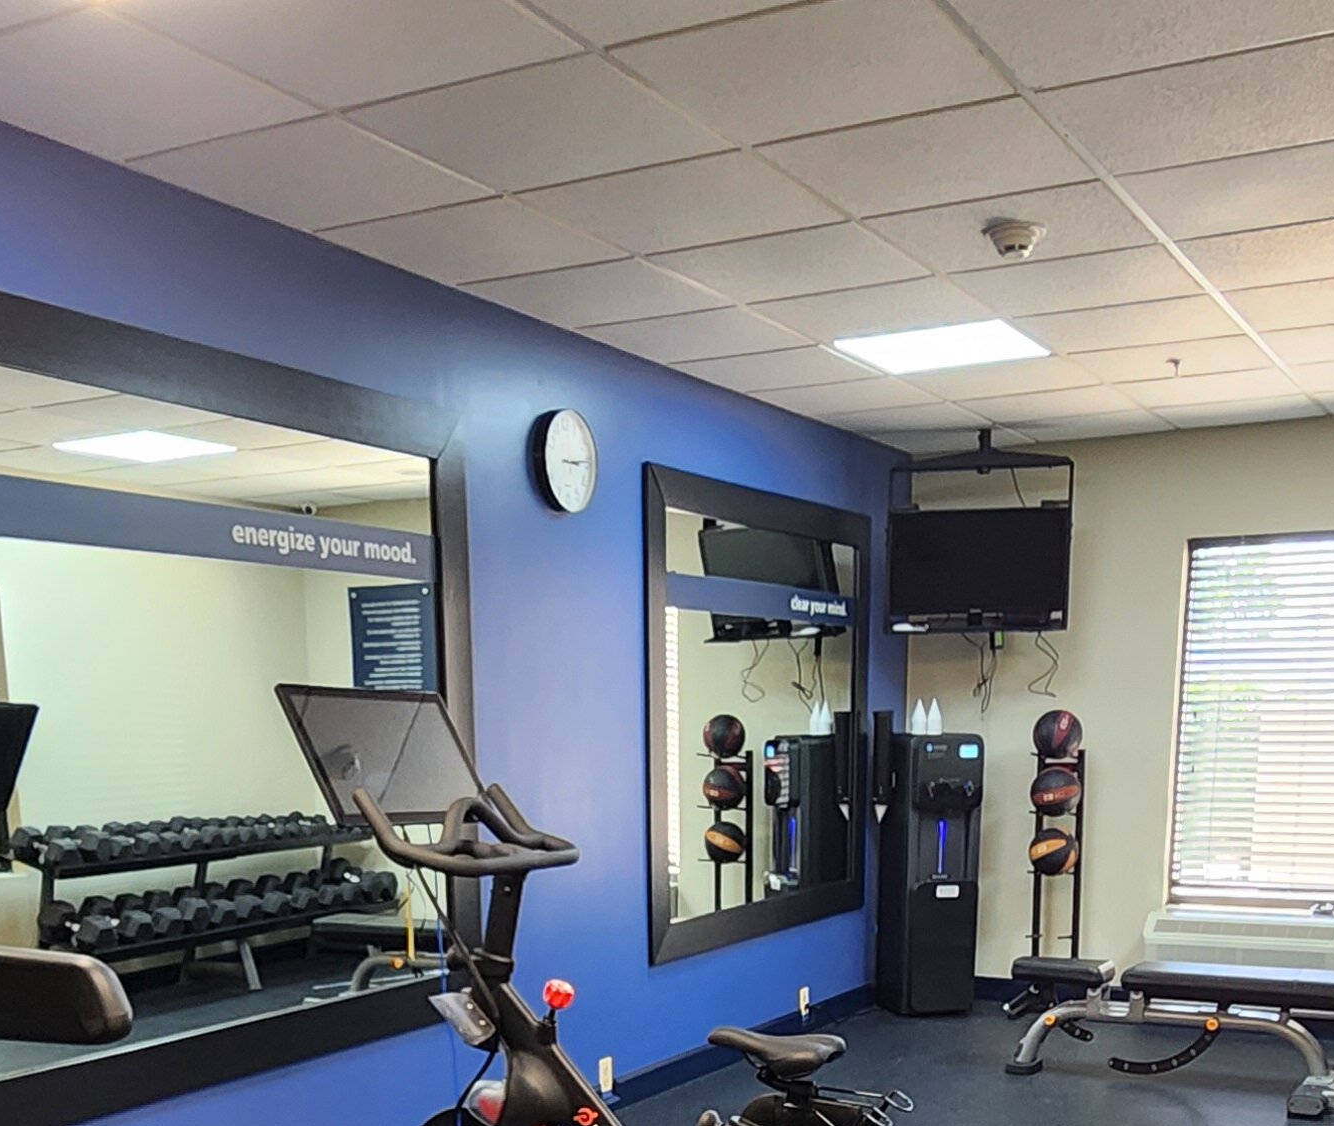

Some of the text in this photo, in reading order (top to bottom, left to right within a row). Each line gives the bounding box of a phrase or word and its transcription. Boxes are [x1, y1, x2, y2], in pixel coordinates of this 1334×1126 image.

[232, 524, 417, 563] energize your mood.
[790, 593, 809, 612] clear
[810, 601, 827, 616] your
